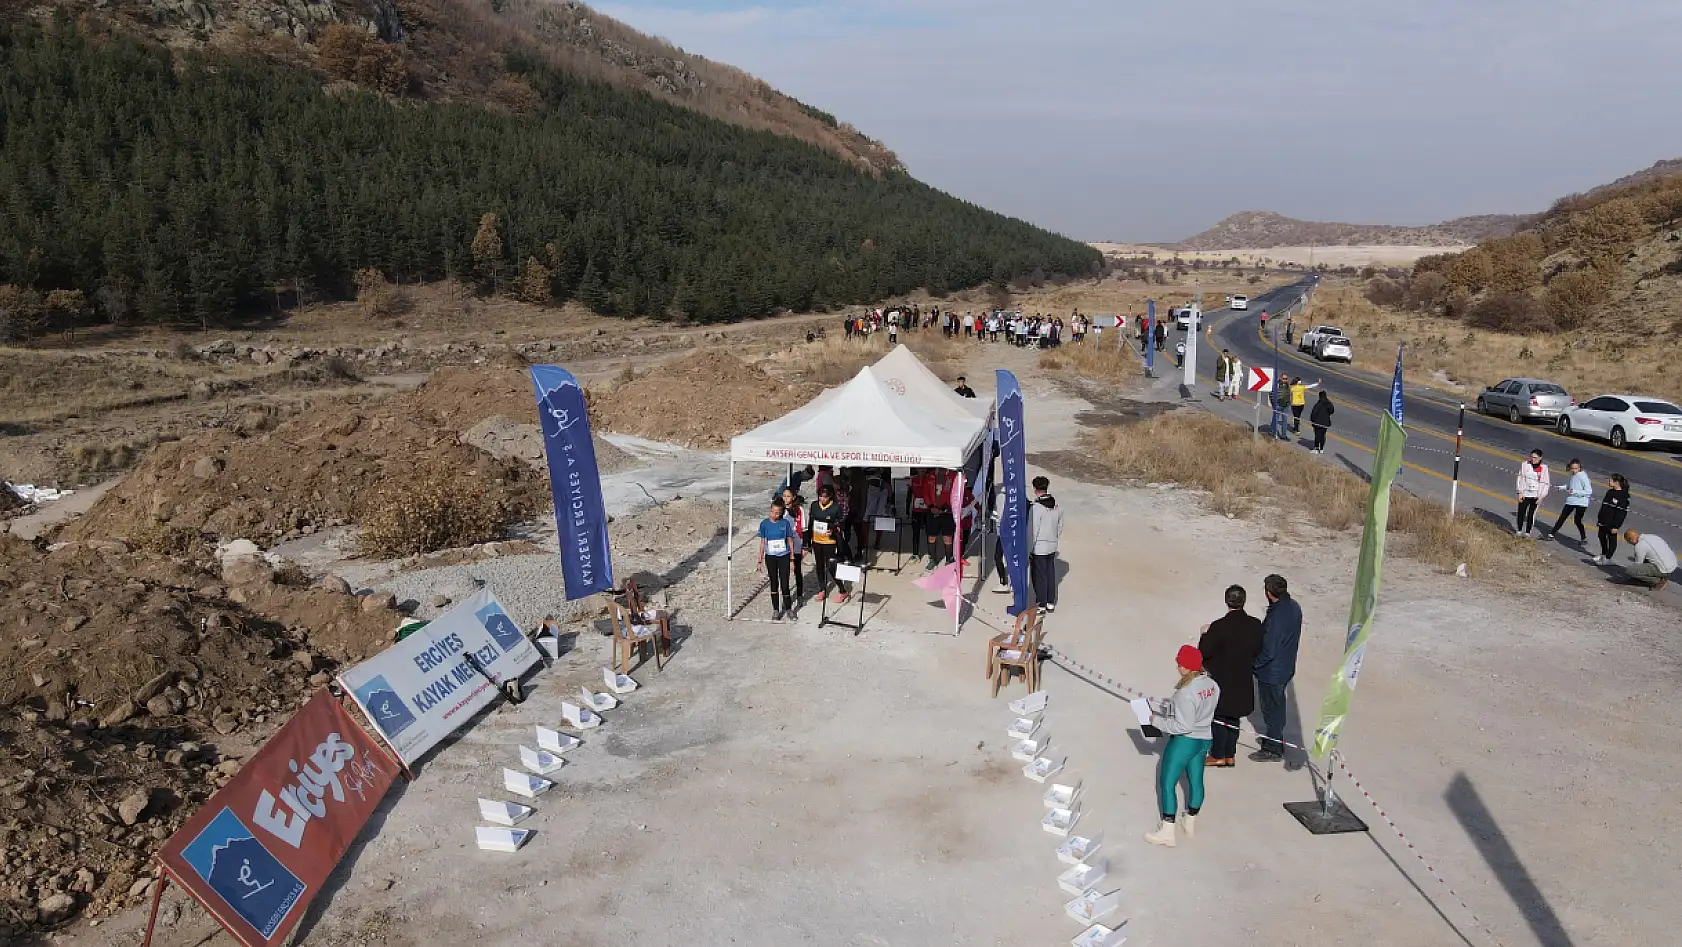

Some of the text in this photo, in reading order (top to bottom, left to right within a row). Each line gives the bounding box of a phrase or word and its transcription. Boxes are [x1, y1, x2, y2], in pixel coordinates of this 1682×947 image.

[766, 448, 796, 459] KAYSERİ
[797, 449, 829, 461] GENÇLİK
[830, 452, 840, 460] VE
[841, 452, 861, 461] SPOR
[871, 452, 922, 465] MÜDÜRLÜĞÜ
[413, 632, 464, 673] ERCİYES
[412, 674, 458, 714] KAYAK
[252, 732, 354, 850] Erciyes
